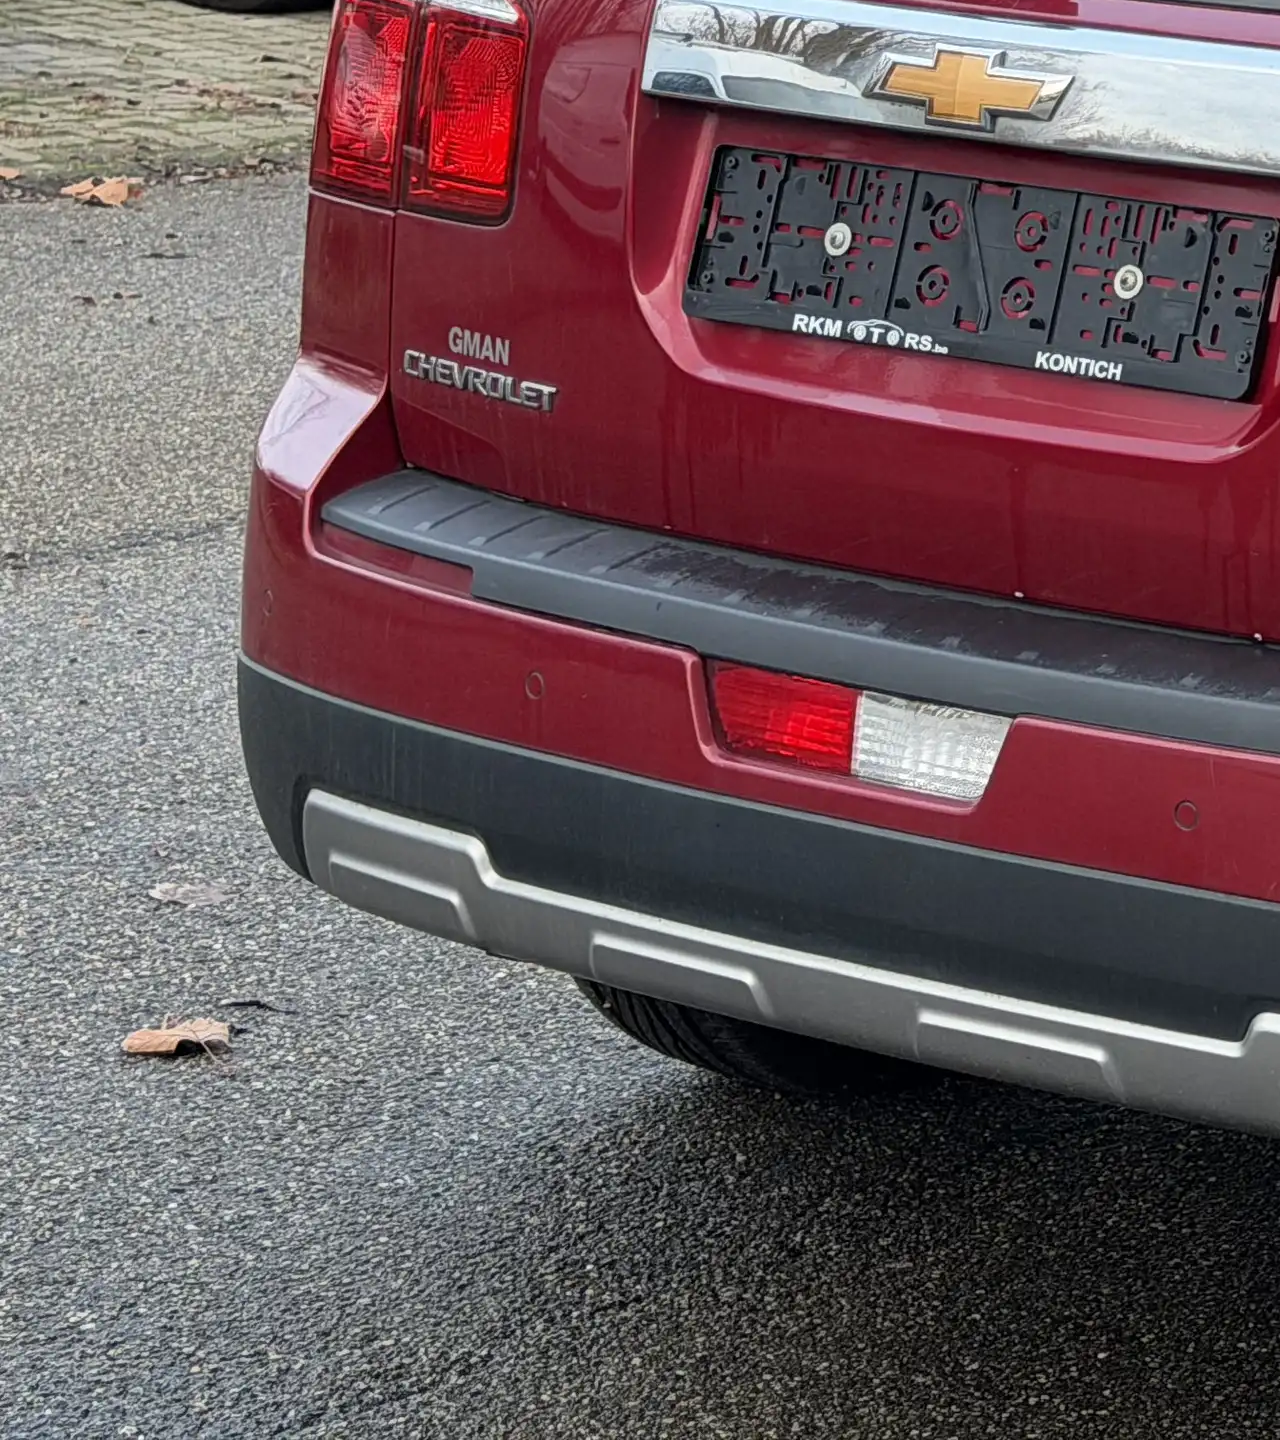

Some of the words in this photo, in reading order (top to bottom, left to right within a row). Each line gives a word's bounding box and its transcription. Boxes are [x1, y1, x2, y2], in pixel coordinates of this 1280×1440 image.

[448, 325, 510, 366] GMAN
[1034, 350, 1123, 381] KONTICH
[404, 348, 558, 411] CHEVROLET
